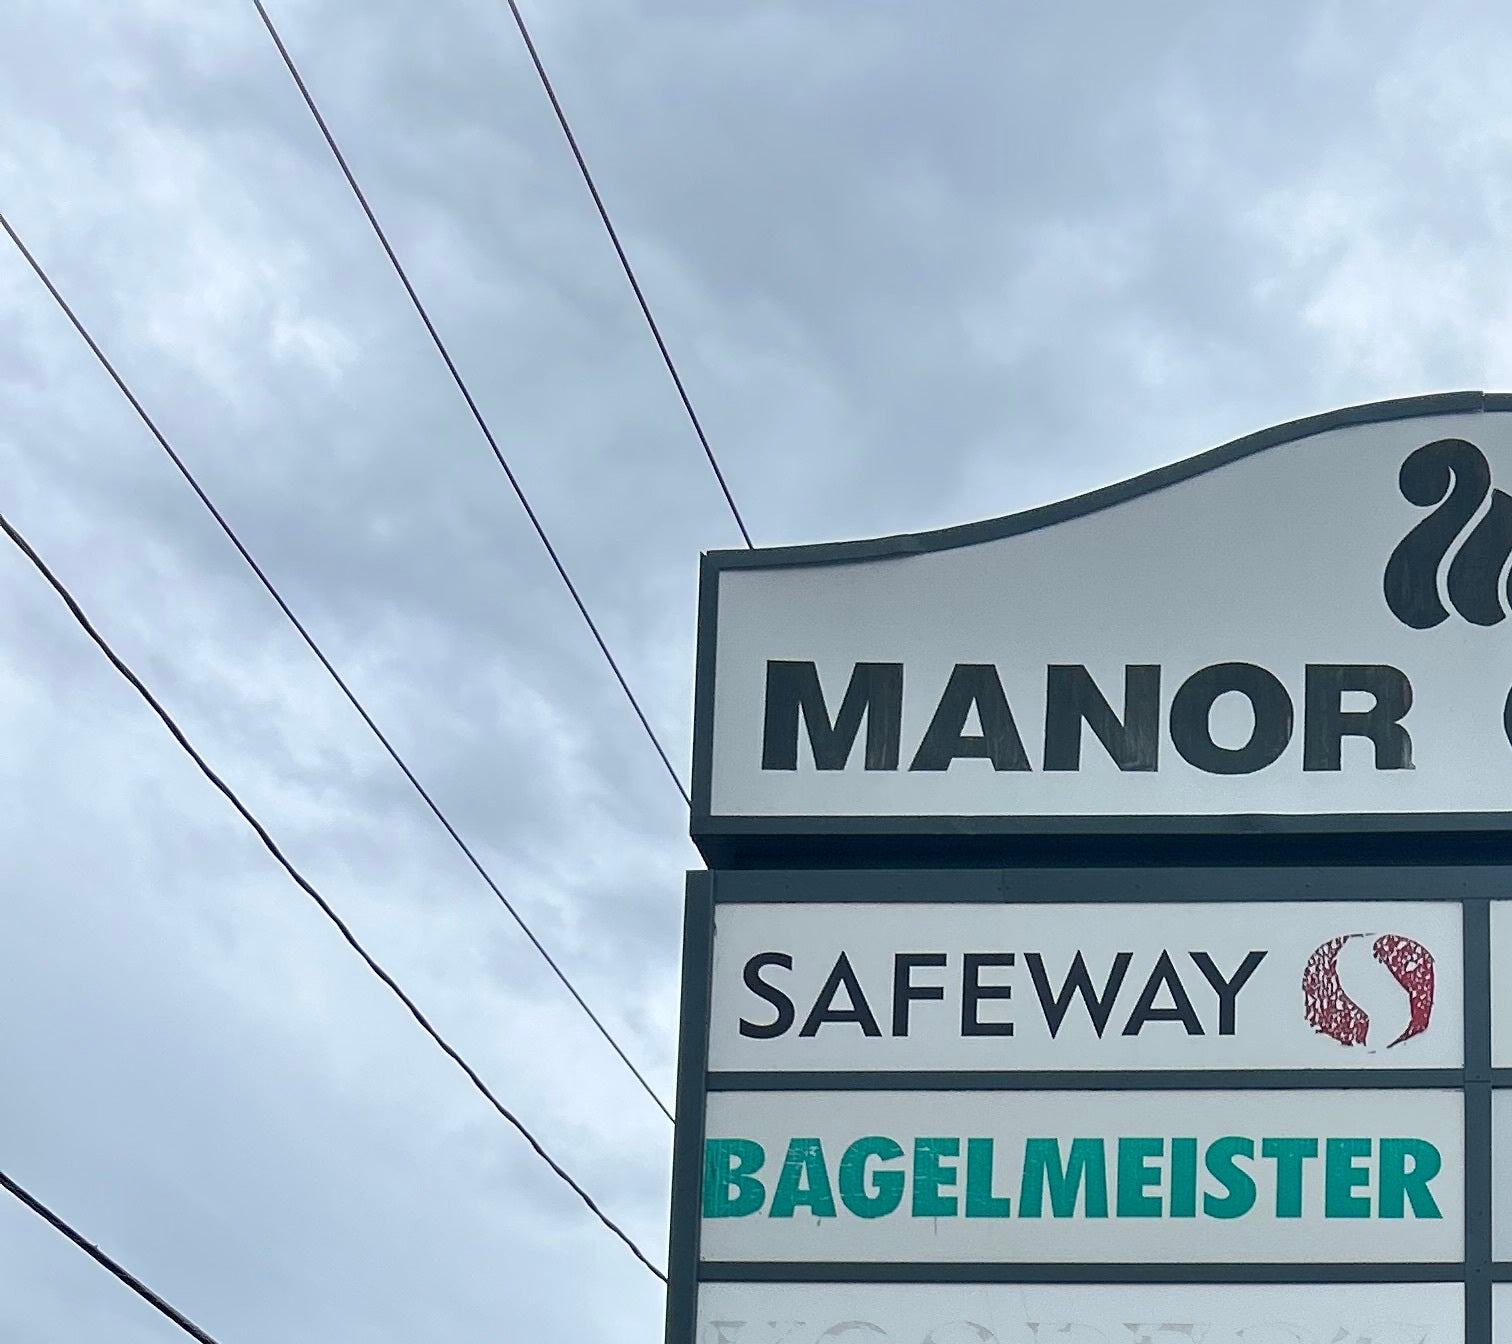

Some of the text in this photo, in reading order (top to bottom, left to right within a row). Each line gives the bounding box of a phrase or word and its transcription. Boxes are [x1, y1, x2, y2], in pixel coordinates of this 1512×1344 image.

[761, 660, 1415, 775] MANOR
[739, 949, 1268, 1039] SAFEWAY
[705, 1136, 1443, 1219] BAGELMEISTER
